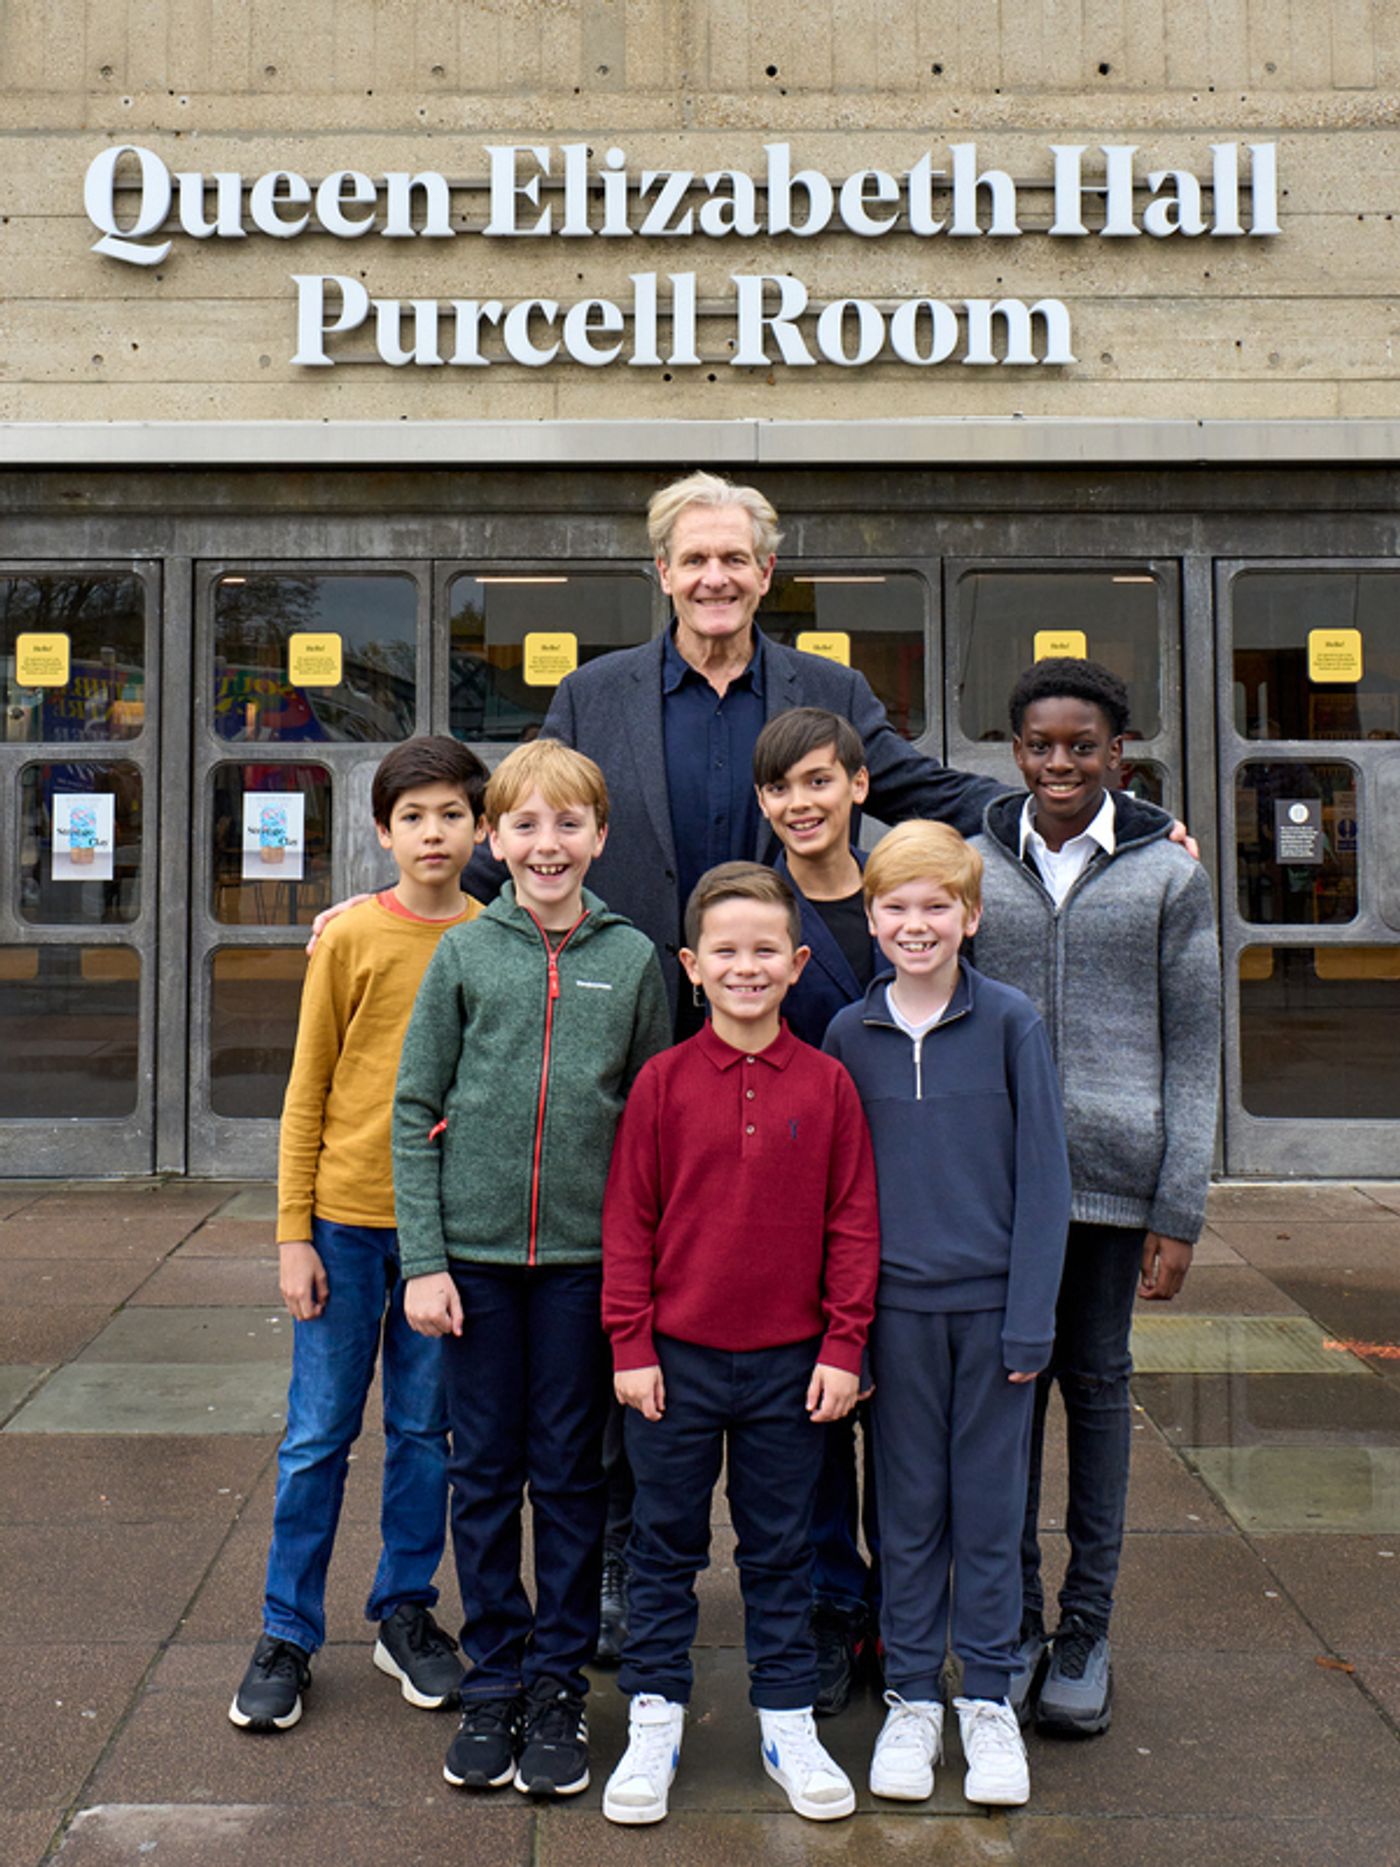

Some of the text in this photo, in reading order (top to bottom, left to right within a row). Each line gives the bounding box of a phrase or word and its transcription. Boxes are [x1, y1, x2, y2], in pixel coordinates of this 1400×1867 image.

[83, 142, 1281, 266] Queen Elizabeth Hall
[290, 271, 1075, 367] Purcell Room
